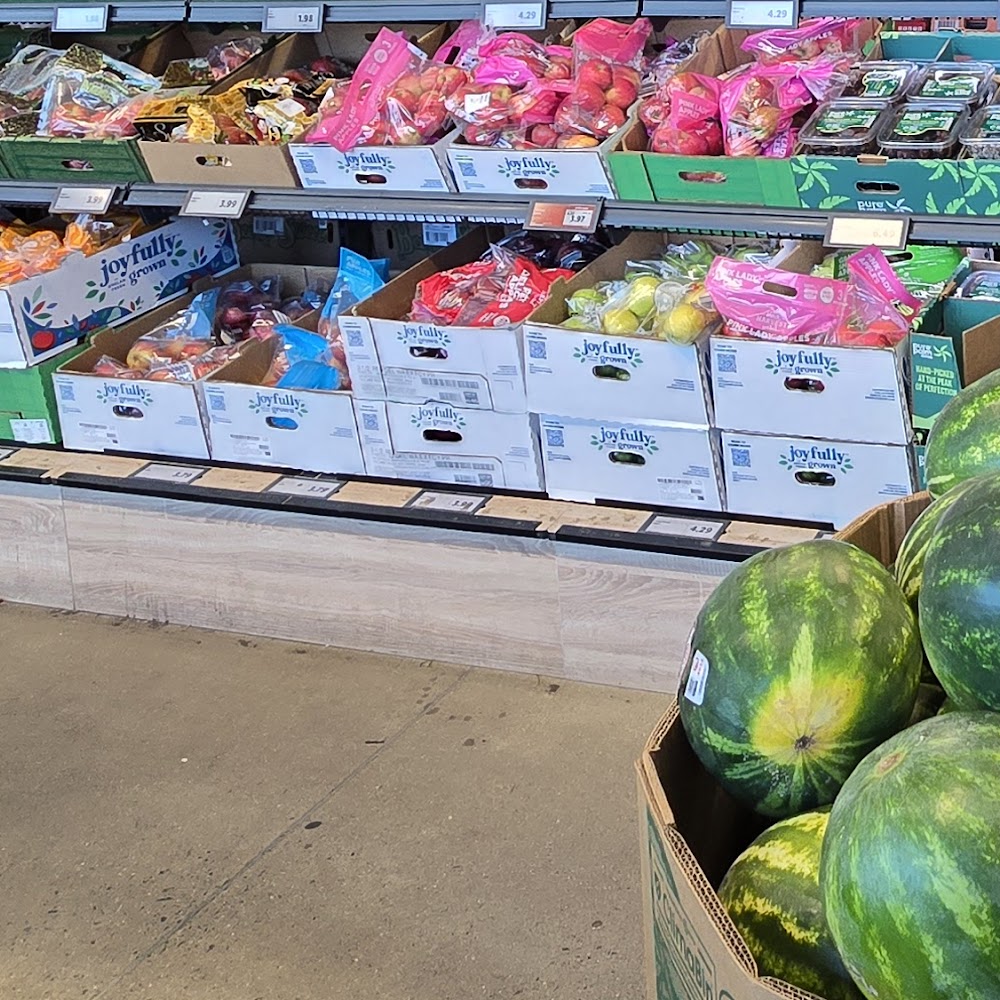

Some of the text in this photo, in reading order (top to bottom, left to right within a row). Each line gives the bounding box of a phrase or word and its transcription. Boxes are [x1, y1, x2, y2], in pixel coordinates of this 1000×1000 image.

[517, 10, 537, 20] 4.29
[767, 8, 788, 19] 4.29
[802, 30, 833, 46] APPLES
[343, 152, 388, 167] joyfully
[504, 156, 551, 172] joyfully
[86, 195, 103, 204] 3.99
[219, 200, 238, 208] 3.99
[100, 233, 176, 288] joyfully
[129, 259, 167, 287] grown
[858, 257, 881, 286] APPLES
[865, 252, 894, 294] PINK LADY
[401, 324, 445, 340] joyfully
[582, 338, 636, 360] joyfully
[600, 355, 628, 365] grown
[775, 349, 833, 369] joyfully
[794, 364, 824, 375] grown
[103, 381, 150, 399] joyfully
[923, 384, 958, 397] PERFECTION
[256, 392, 302, 410] joyfully
[417, 406, 460, 422] joyfully
[599, 426, 652, 446] joyfully
[788, 445, 845, 465] joyfully
[807, 460, 837, 471] grown
[690, 524, 713, 534] 4.29
